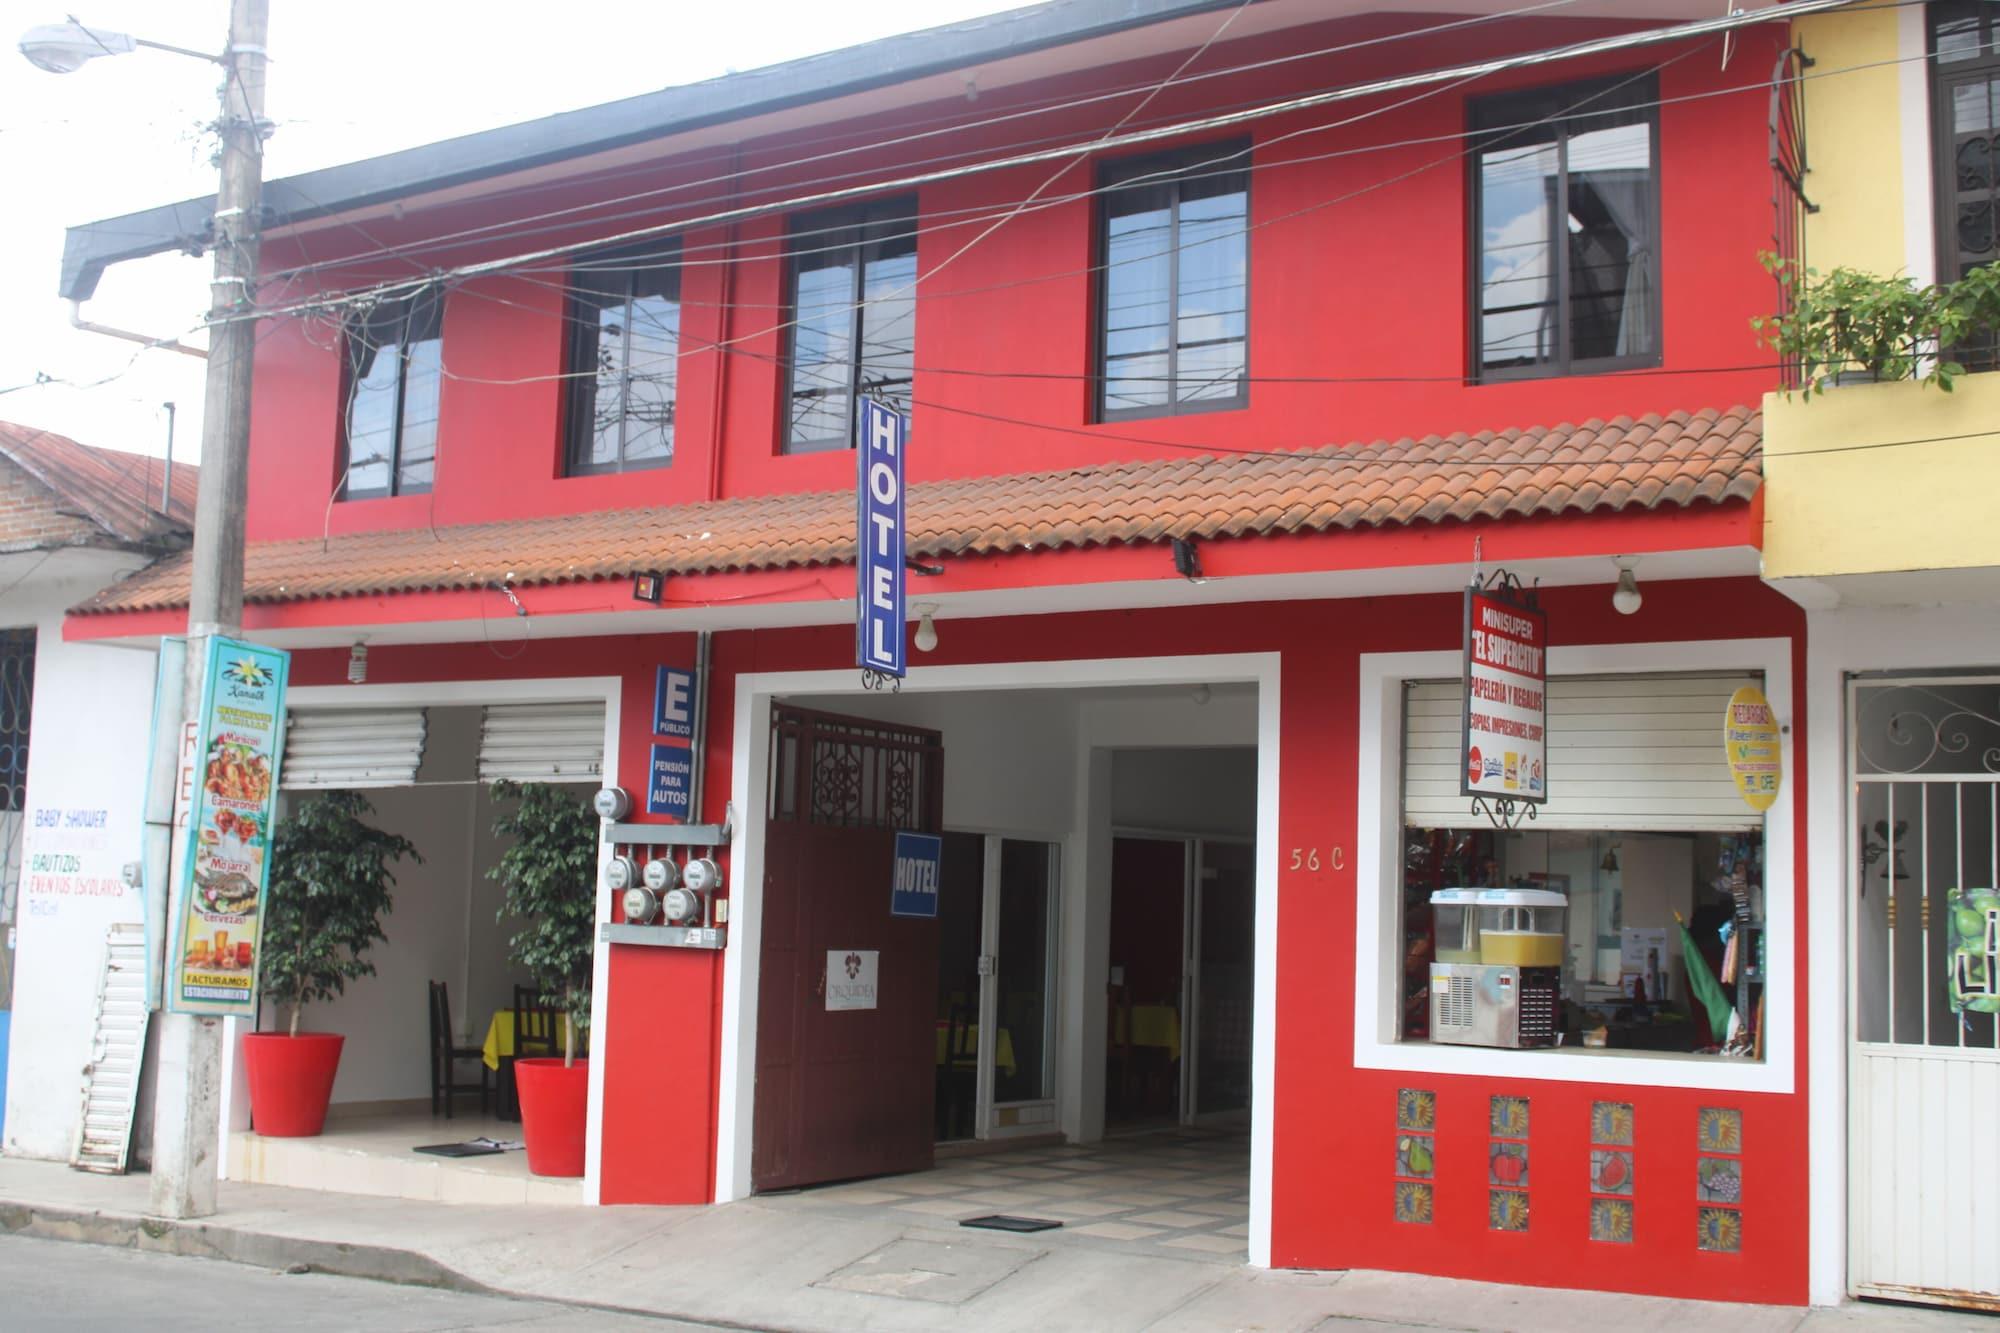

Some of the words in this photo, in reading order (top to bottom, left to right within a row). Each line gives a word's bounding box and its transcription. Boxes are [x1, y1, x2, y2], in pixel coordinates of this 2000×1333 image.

[869, 409, 898, 664] HOTEL
[1482, 606, 1534, 640] MINISUPER
[664, 671, 690, 722] E
[1507, 685, 1513, 704] Y
[1513, 686, 1543, 712] REGALOS
[660, 721, 691, 736] PÚBLICO
[655, 760, 690, 774] PENSIÓN
[660, 775, 682, 788] PARA
[652, 790, 688, 806] AUTOS
[35, 809, 61, 828] BABY
[64, 809, 108, 829] SHOWER
[32, 853, 81, 873] BAUTIZOS
[1290, 847, 1320, 871] 56
[29, 875, 71, 895] EVENTOS
[895, 857, 937, 894] HOTEL
[186, 975, 249, 987] FACTURAMOS
